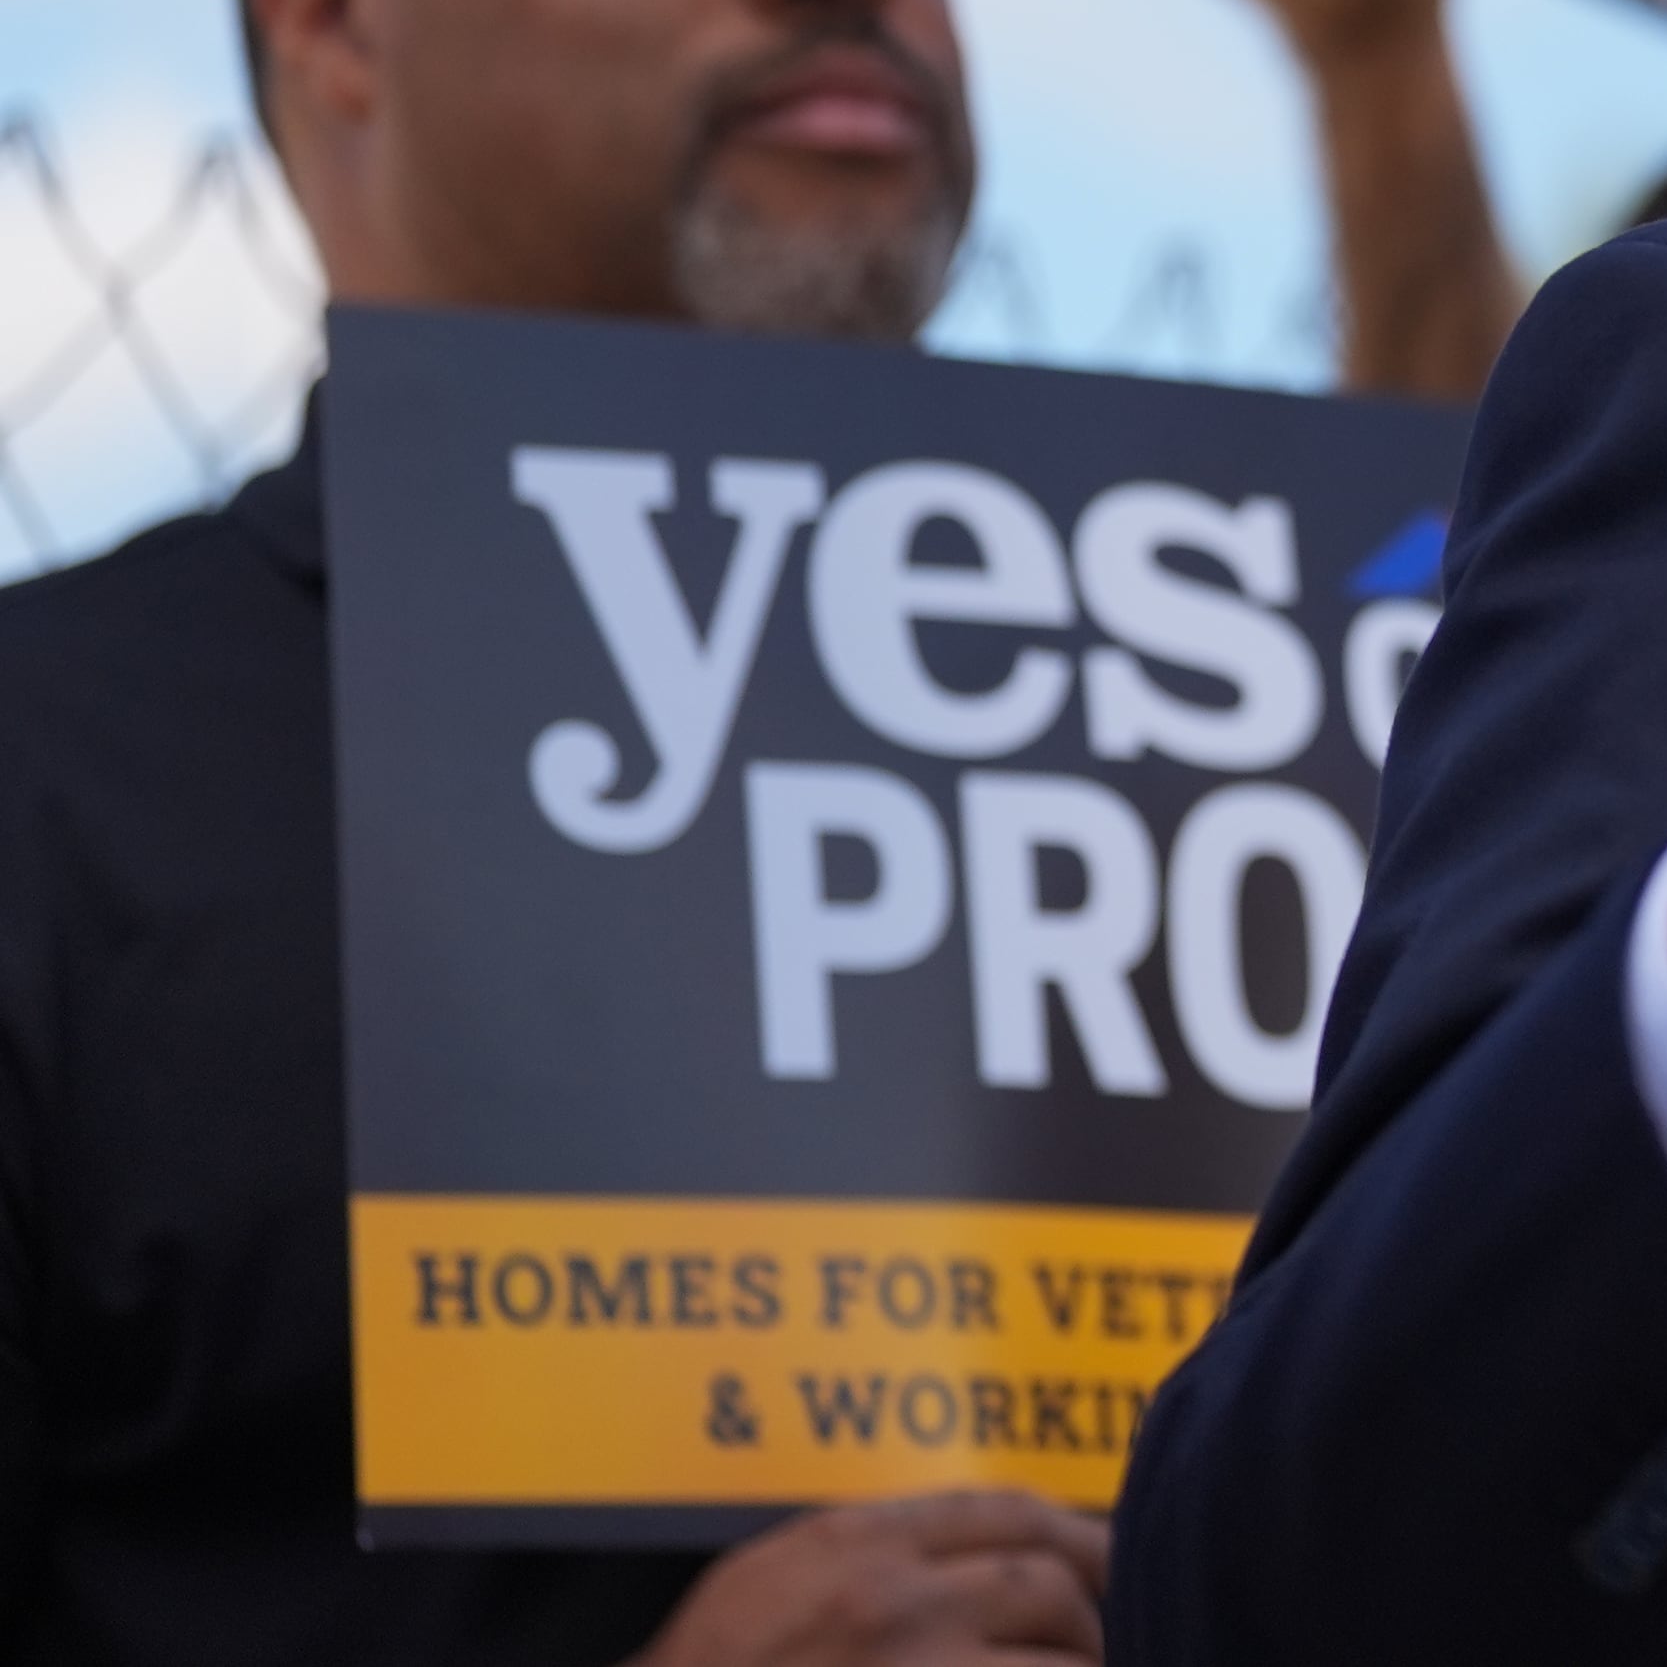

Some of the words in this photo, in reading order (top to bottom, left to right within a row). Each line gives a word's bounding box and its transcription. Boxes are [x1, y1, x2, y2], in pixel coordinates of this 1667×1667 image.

[508, 443, 1326, 855] yes
[741, 757, 1372, 1113] PRO
[412, 1249, 786, 1331] HOMES
[818, 1253, 1004, 1333] FOR
[704, 1371, 762, 1449] &
